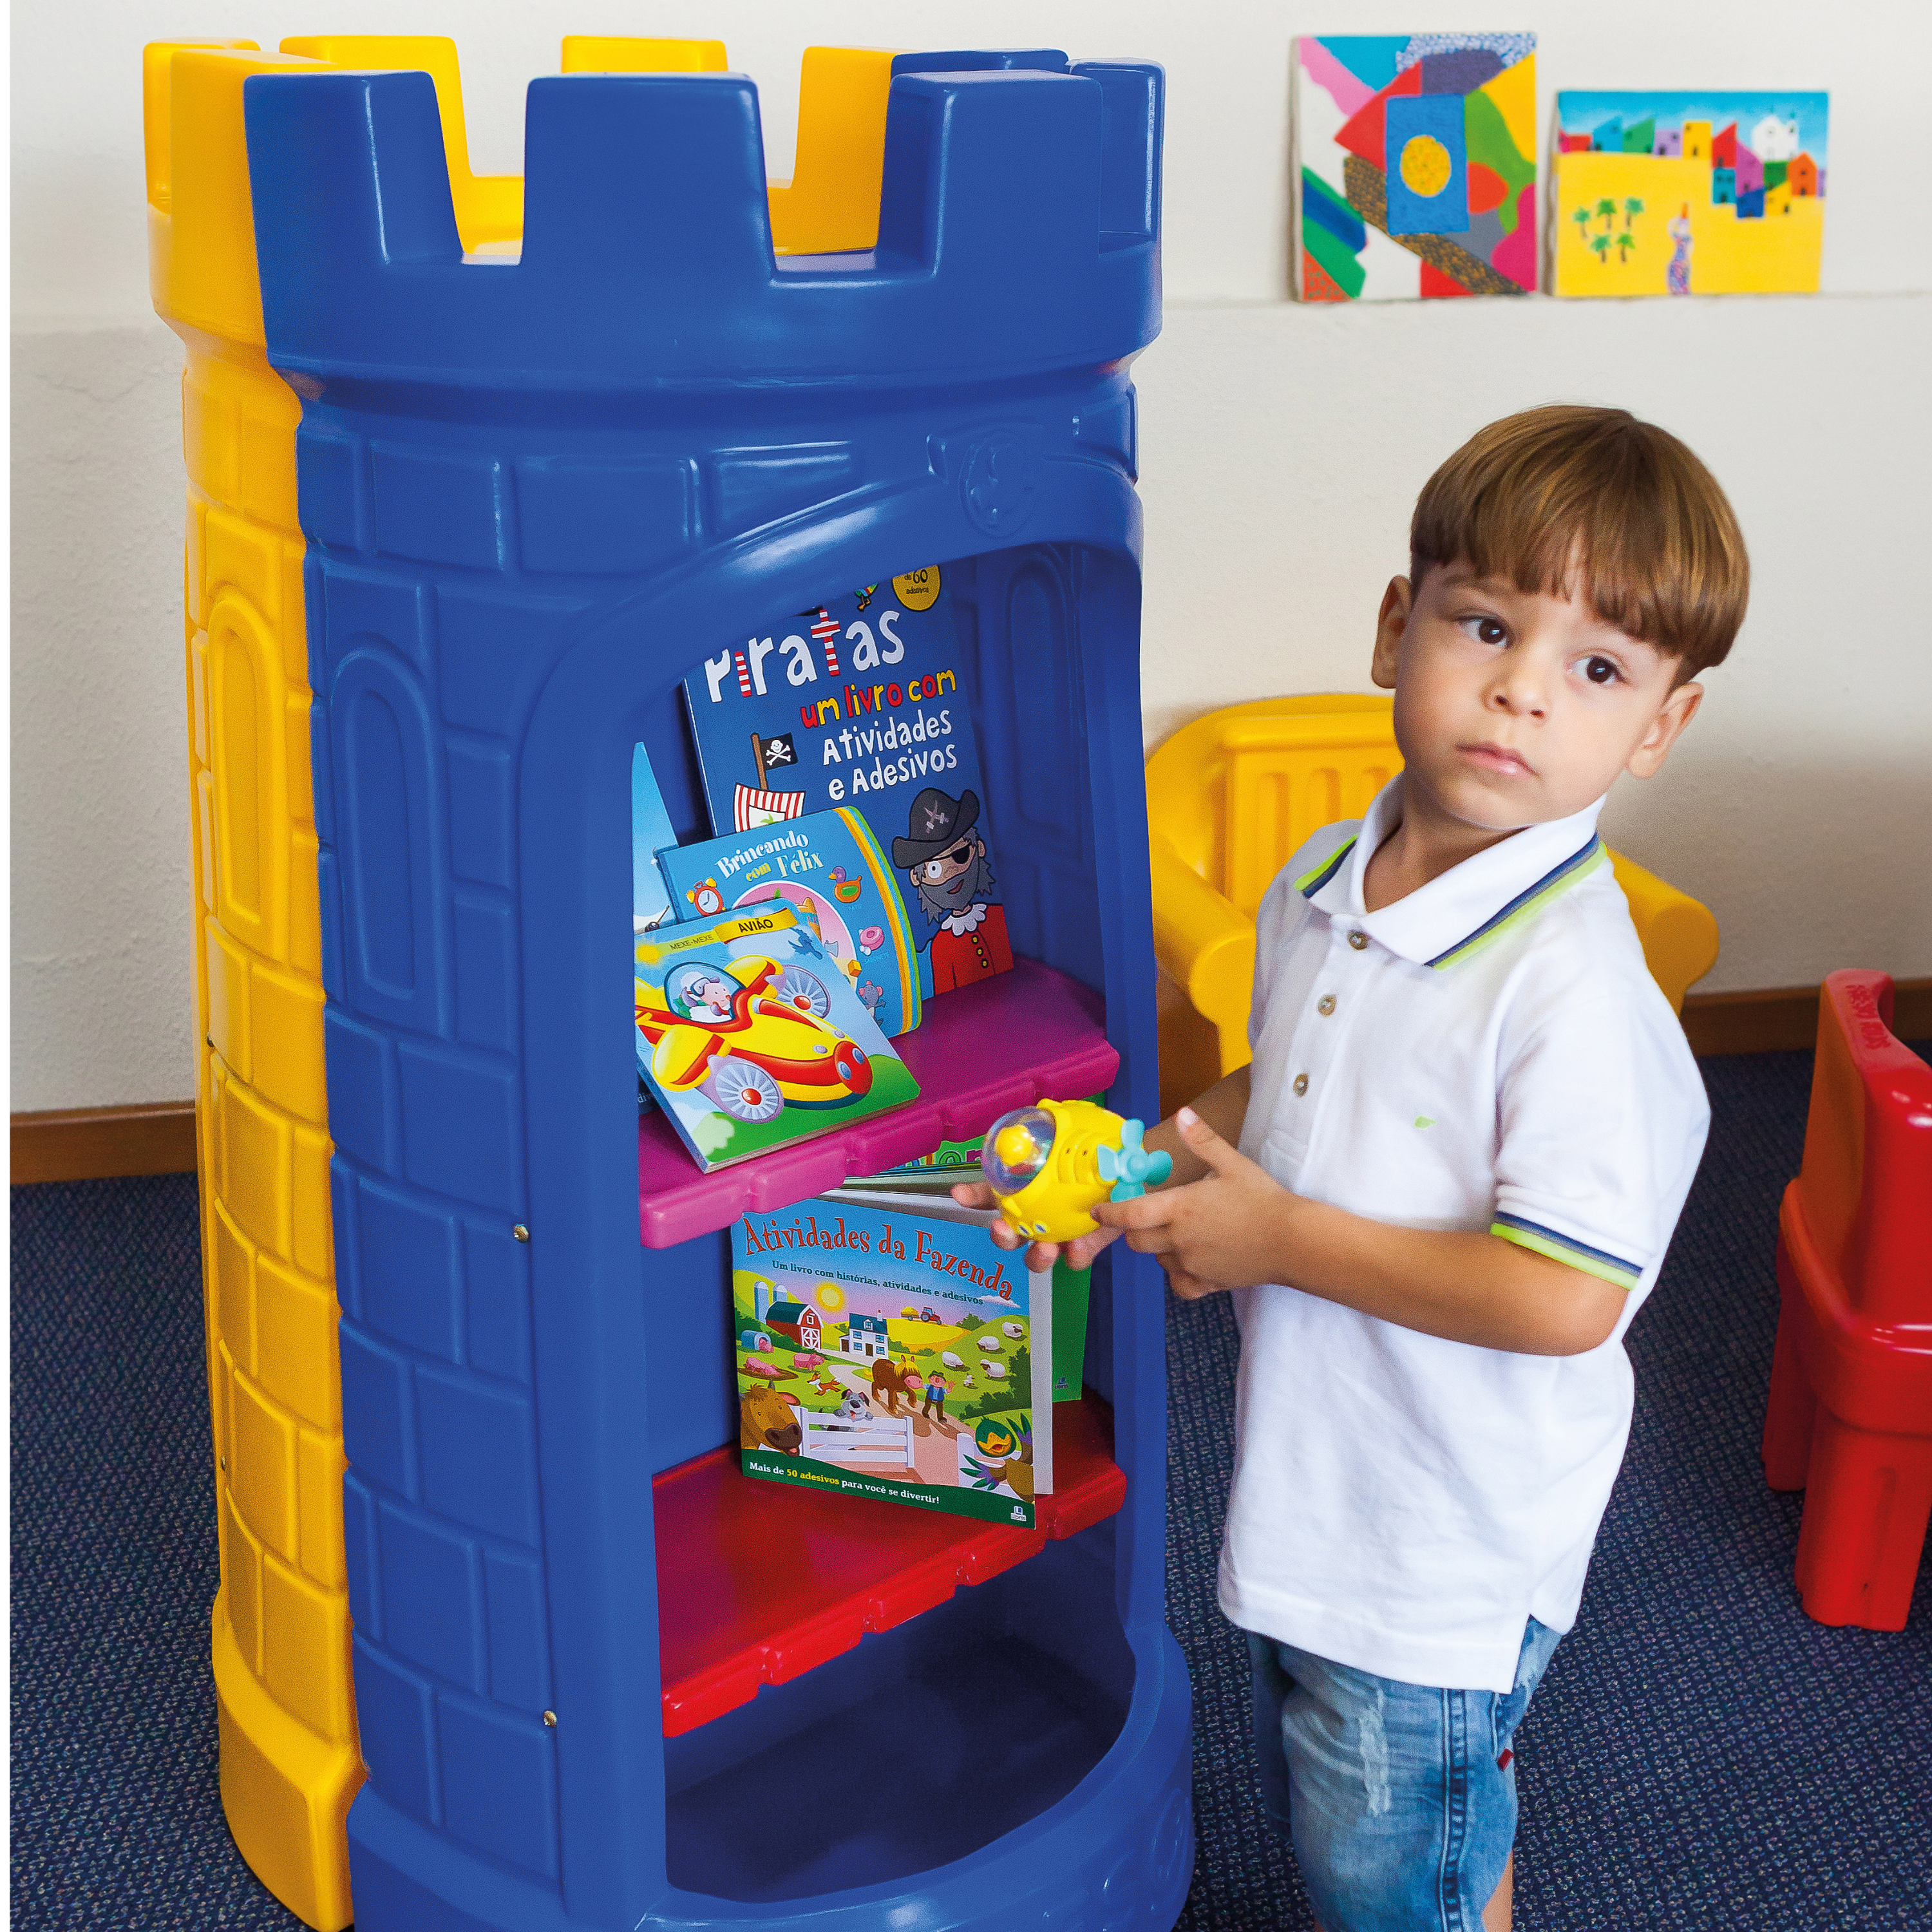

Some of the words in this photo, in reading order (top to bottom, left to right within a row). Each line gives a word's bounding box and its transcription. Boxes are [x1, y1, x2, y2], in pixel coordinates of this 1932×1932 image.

[913, 569, 928, 583] 60
[800, 696, 840, 728] um
[844, 683, 902, 718] livro
[908, 669, 957, 701] com
[822, 709, 952, 766] Atividades
[828, 777, 845, 801] e
[852, 743, 958, 795] Adesivos
[714, 830, 809, 878] Brincando
[746, 862, 772, 882] com
[775, 849, 824, 878] Félix
[670, 934, 715, 951] MEXE-MEXE
[738, 918, 773, 933] AVIÃO
[743, 1217, 870, 1255] Atividades
[878, 1224, 906, 1260] da
[914, 1229, 1013, 1301] Fazenda
[772, 1260, 788, 1271] Um
[790, 1263, 813, 1274] livro
[815, 1269, 834, 1278] com
[837, 1271, 880, 1287] histórias,
[883, 1280, 932, 1295] atividades
[942, 1291, 983, 1305] adesivos
[749, 1461, 772, 1472] Mais
[773, 1466, 784, 1475] de
[786, 1468, 798, 1477] 50
[800, 1472, 840, 1485] adesivos
[841, 1479, 863, 1490] para
[865, 1484, 887, 1493] você
[900, 1490, 940, 1504] divertir!
